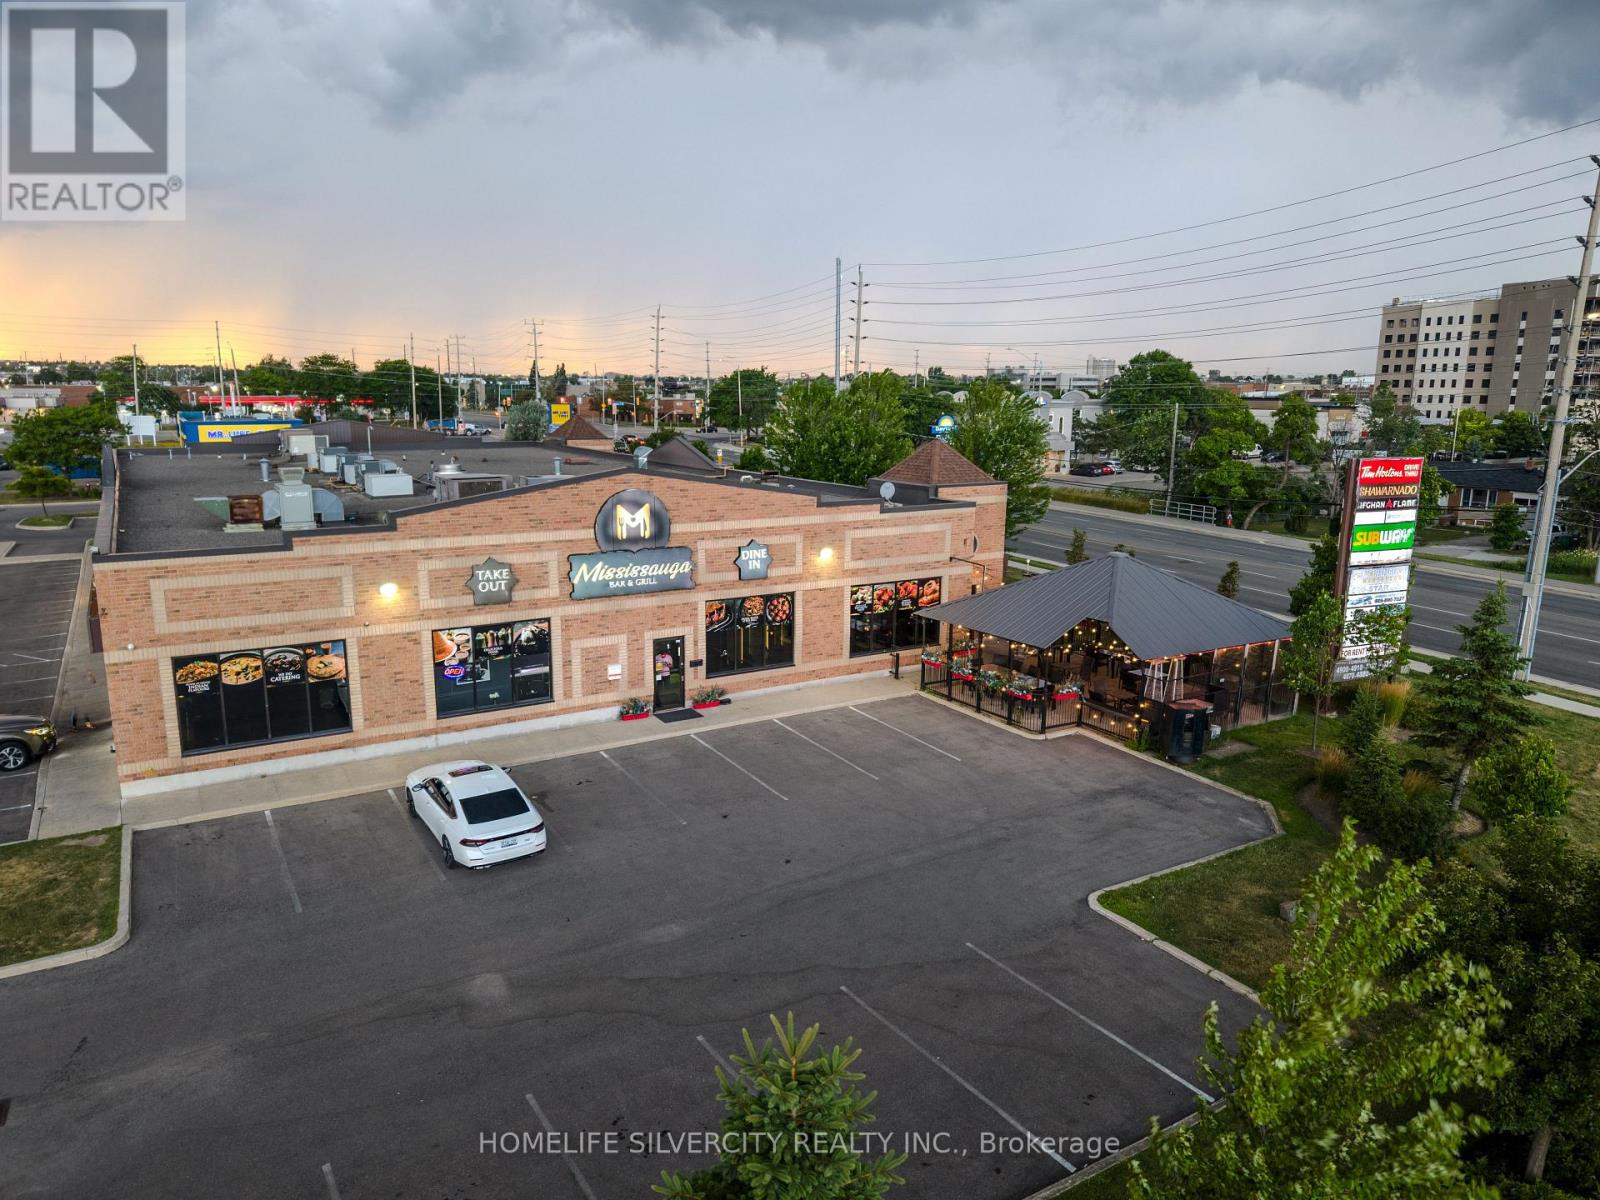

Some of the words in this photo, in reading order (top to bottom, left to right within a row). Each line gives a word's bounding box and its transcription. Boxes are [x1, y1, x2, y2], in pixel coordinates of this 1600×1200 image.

[1361, 466, 1375, 479] Tim
[1375, 465, 1403, 478] Hortons
[1360, 485, 1418, 497] SHAWARNADO
[1393, 499, 1417, 508] FLAME
[1353, 527, 1415, 547] SUBWAY
[741, 548, 768, 560] DINE
[748, 559, 761, 570] IN
[476, 569, 510, 581] TAKE
[573, 559, 692, 584] Mississauga
[478, 580, 508, 592] OUT
[609, 580, 626, 589] BAR
[627, 579, 634, 587] &
[636, 578, 658, 587] GRILL
[444, 667, 465, 676] OPEN
[270, 673, 301, 683] CATERING
